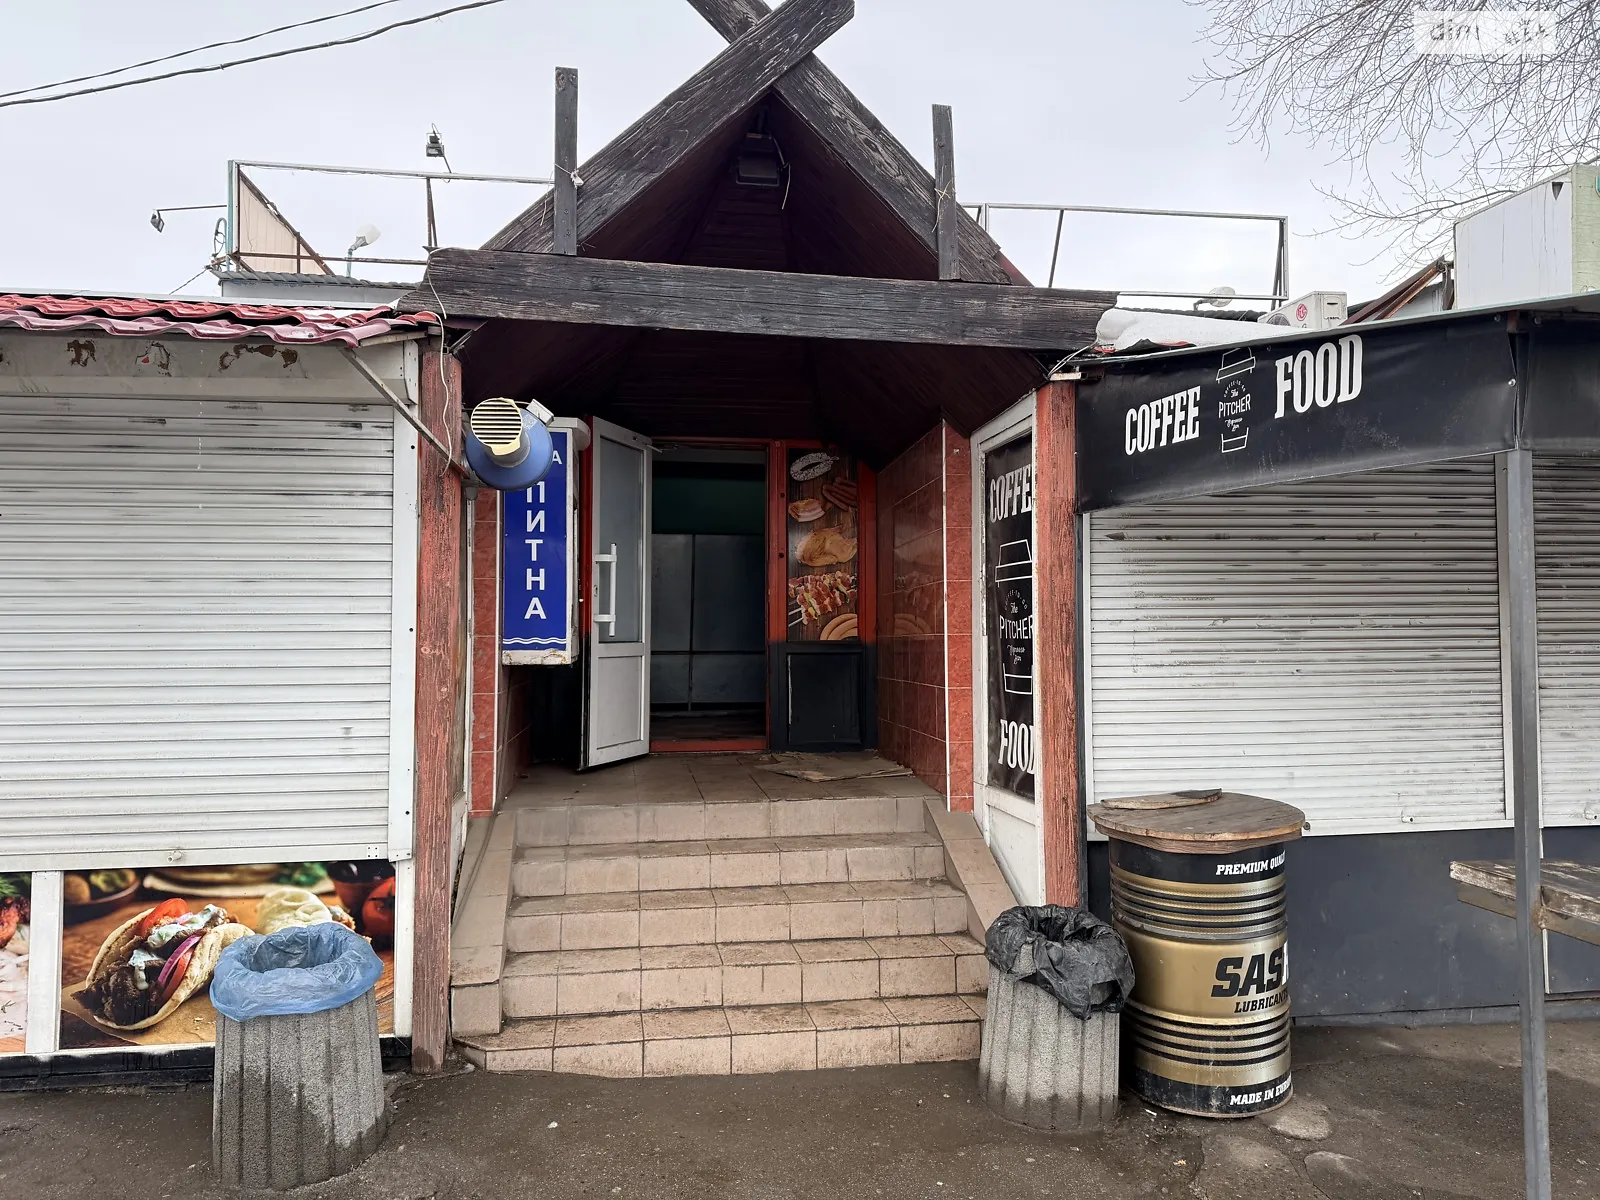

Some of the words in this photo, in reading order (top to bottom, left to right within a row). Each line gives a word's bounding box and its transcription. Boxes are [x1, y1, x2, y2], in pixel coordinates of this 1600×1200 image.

[1124, 385, 1202, 456] COFFEE
[1274, 333, 1364, 420] FOOD
[1218, 393, 1251, 419] PITCHER
[990, 463, 1032, 523] COFFE
[524, 481, 547, 620] ПИТНА
[999, 614, 1033, 639] PITCHER
[1215, 859, 1269, 876] PREMIUM
[1229, 1091, 1263, 1106] MADE
[1263, 1087, 1275, 1101] IN
